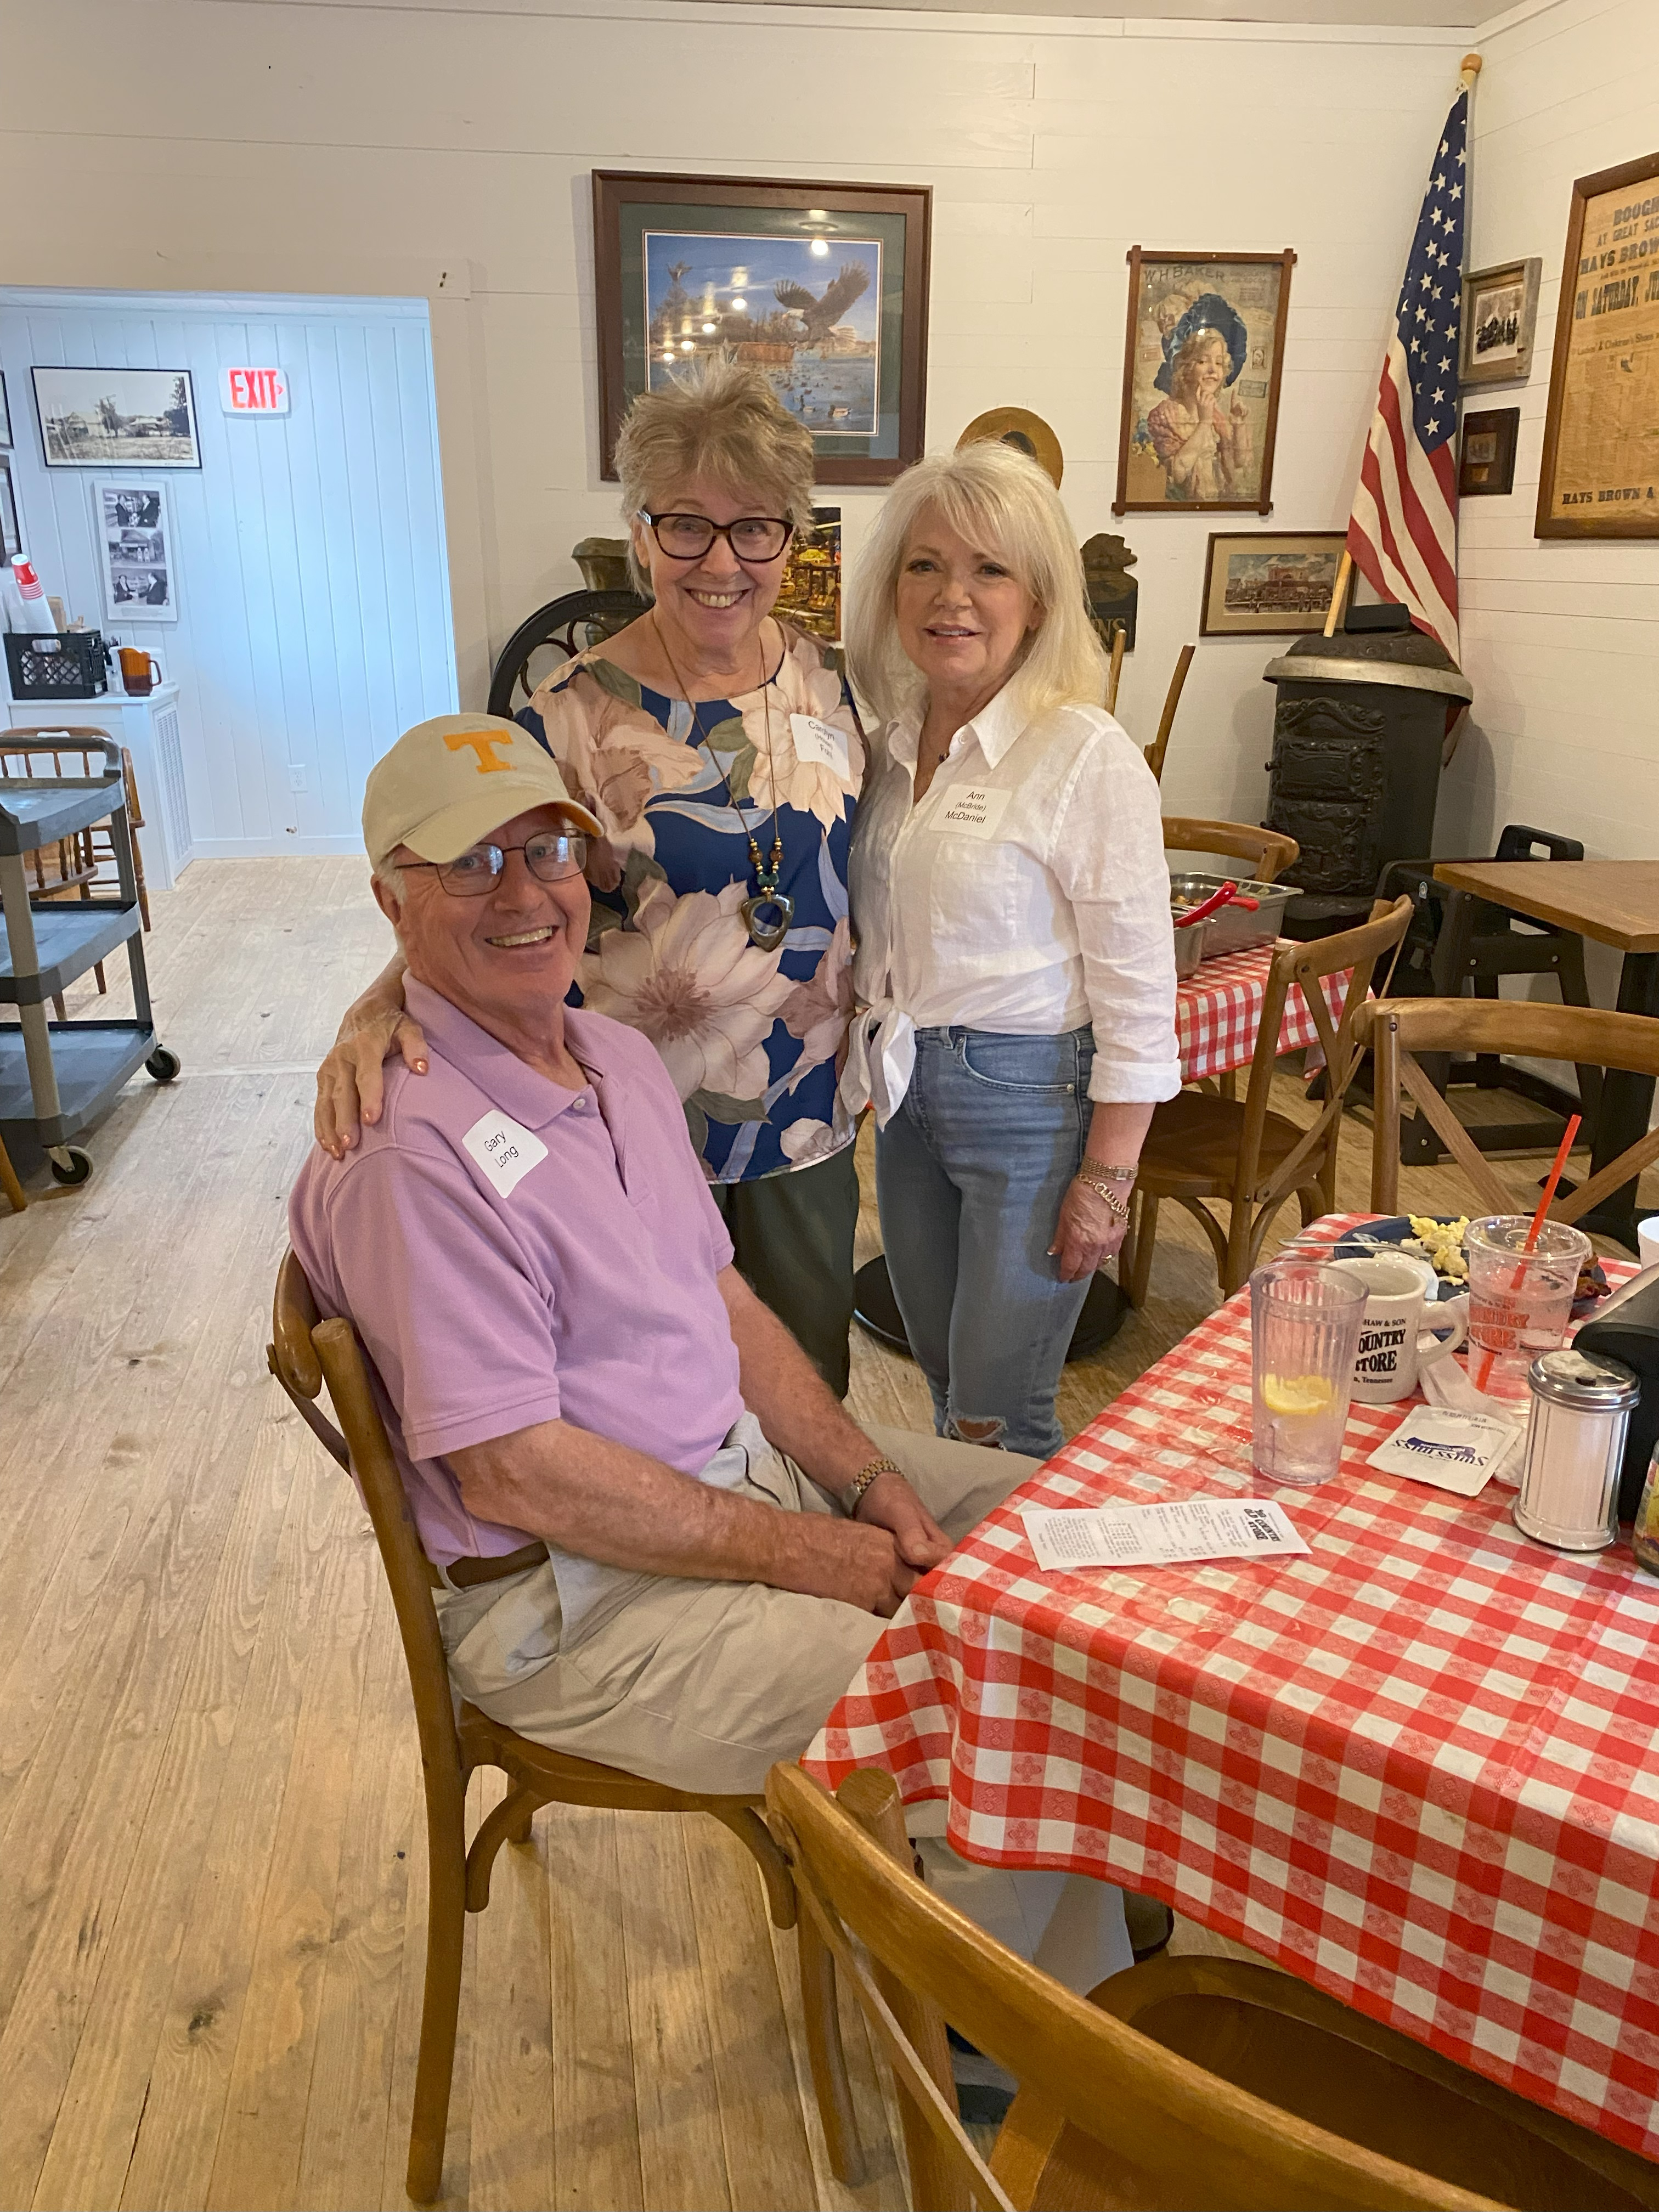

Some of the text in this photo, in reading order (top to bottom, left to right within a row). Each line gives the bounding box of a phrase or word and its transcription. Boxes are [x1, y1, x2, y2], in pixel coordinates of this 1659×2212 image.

[1580, 250, 1616, 274] HAYS
[1173, 266, 1225, 283] BAKER
[230, 370, 277, 408] EXIT
[1562, 491, 1593, 504] HAYS
[1598, 488, 1641, 502] BROWN
[443, 729, 517, 775] T
[966, 791, 985, 800] Ann
[945, 811, 986, 823] McDaniel
[955, 802, 986, 812] (McBride)
[484, 1130, 506, 1152] Gary
[494, 1146, 519, 1168] Long
[1358, 1329, 1406, 1353] OUNTRY
